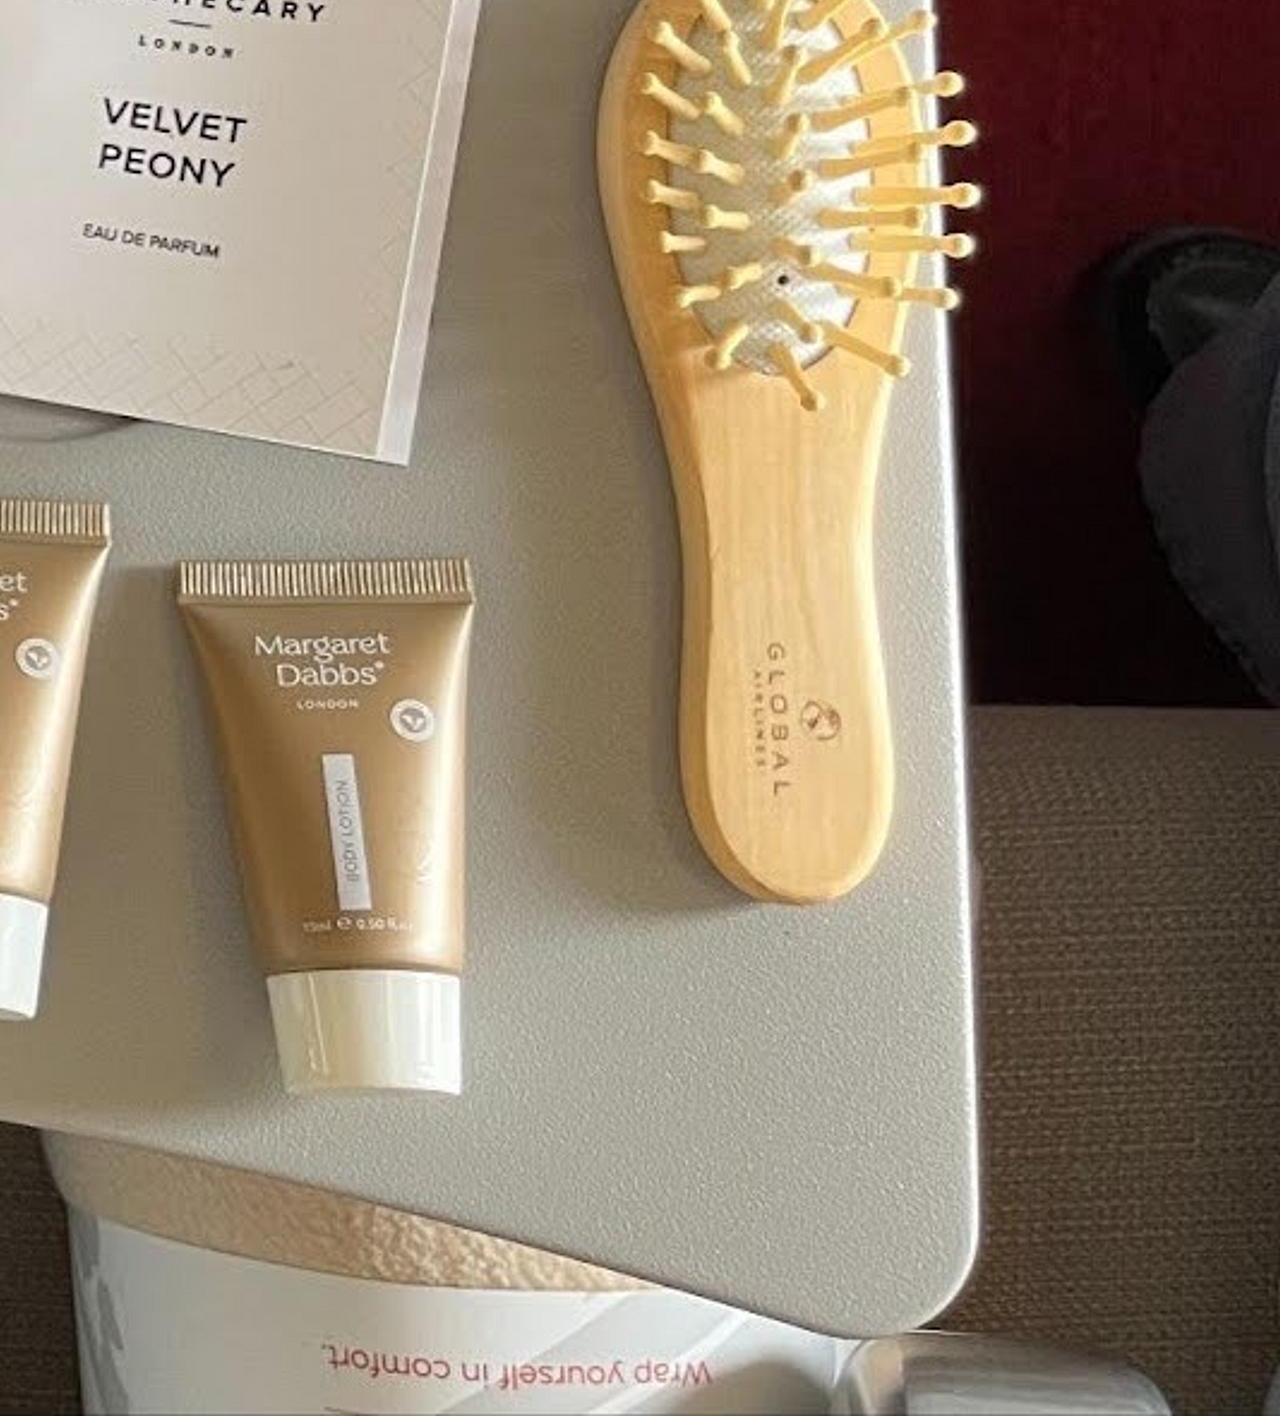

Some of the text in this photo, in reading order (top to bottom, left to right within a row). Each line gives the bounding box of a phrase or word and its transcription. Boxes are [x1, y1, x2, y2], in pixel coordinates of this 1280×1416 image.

[137, 34, 236, 59] LONDON
[103, 96, 249, 144] VELVET
[97, 142, 236, 188] PEONY
[81, 222, 222, 260] EAU DE PARFUM
[253, 632, 392, 663] Margaret
[296, 698, 360, 711] LONDON
[753, 669, 767, 768] AIRLINES
[766, 641, 792, 797] GLOBAL
[336, 780, 354, 836] LOTION
[321, 1344, 714, 1391] Wrap yourself in comfort.
